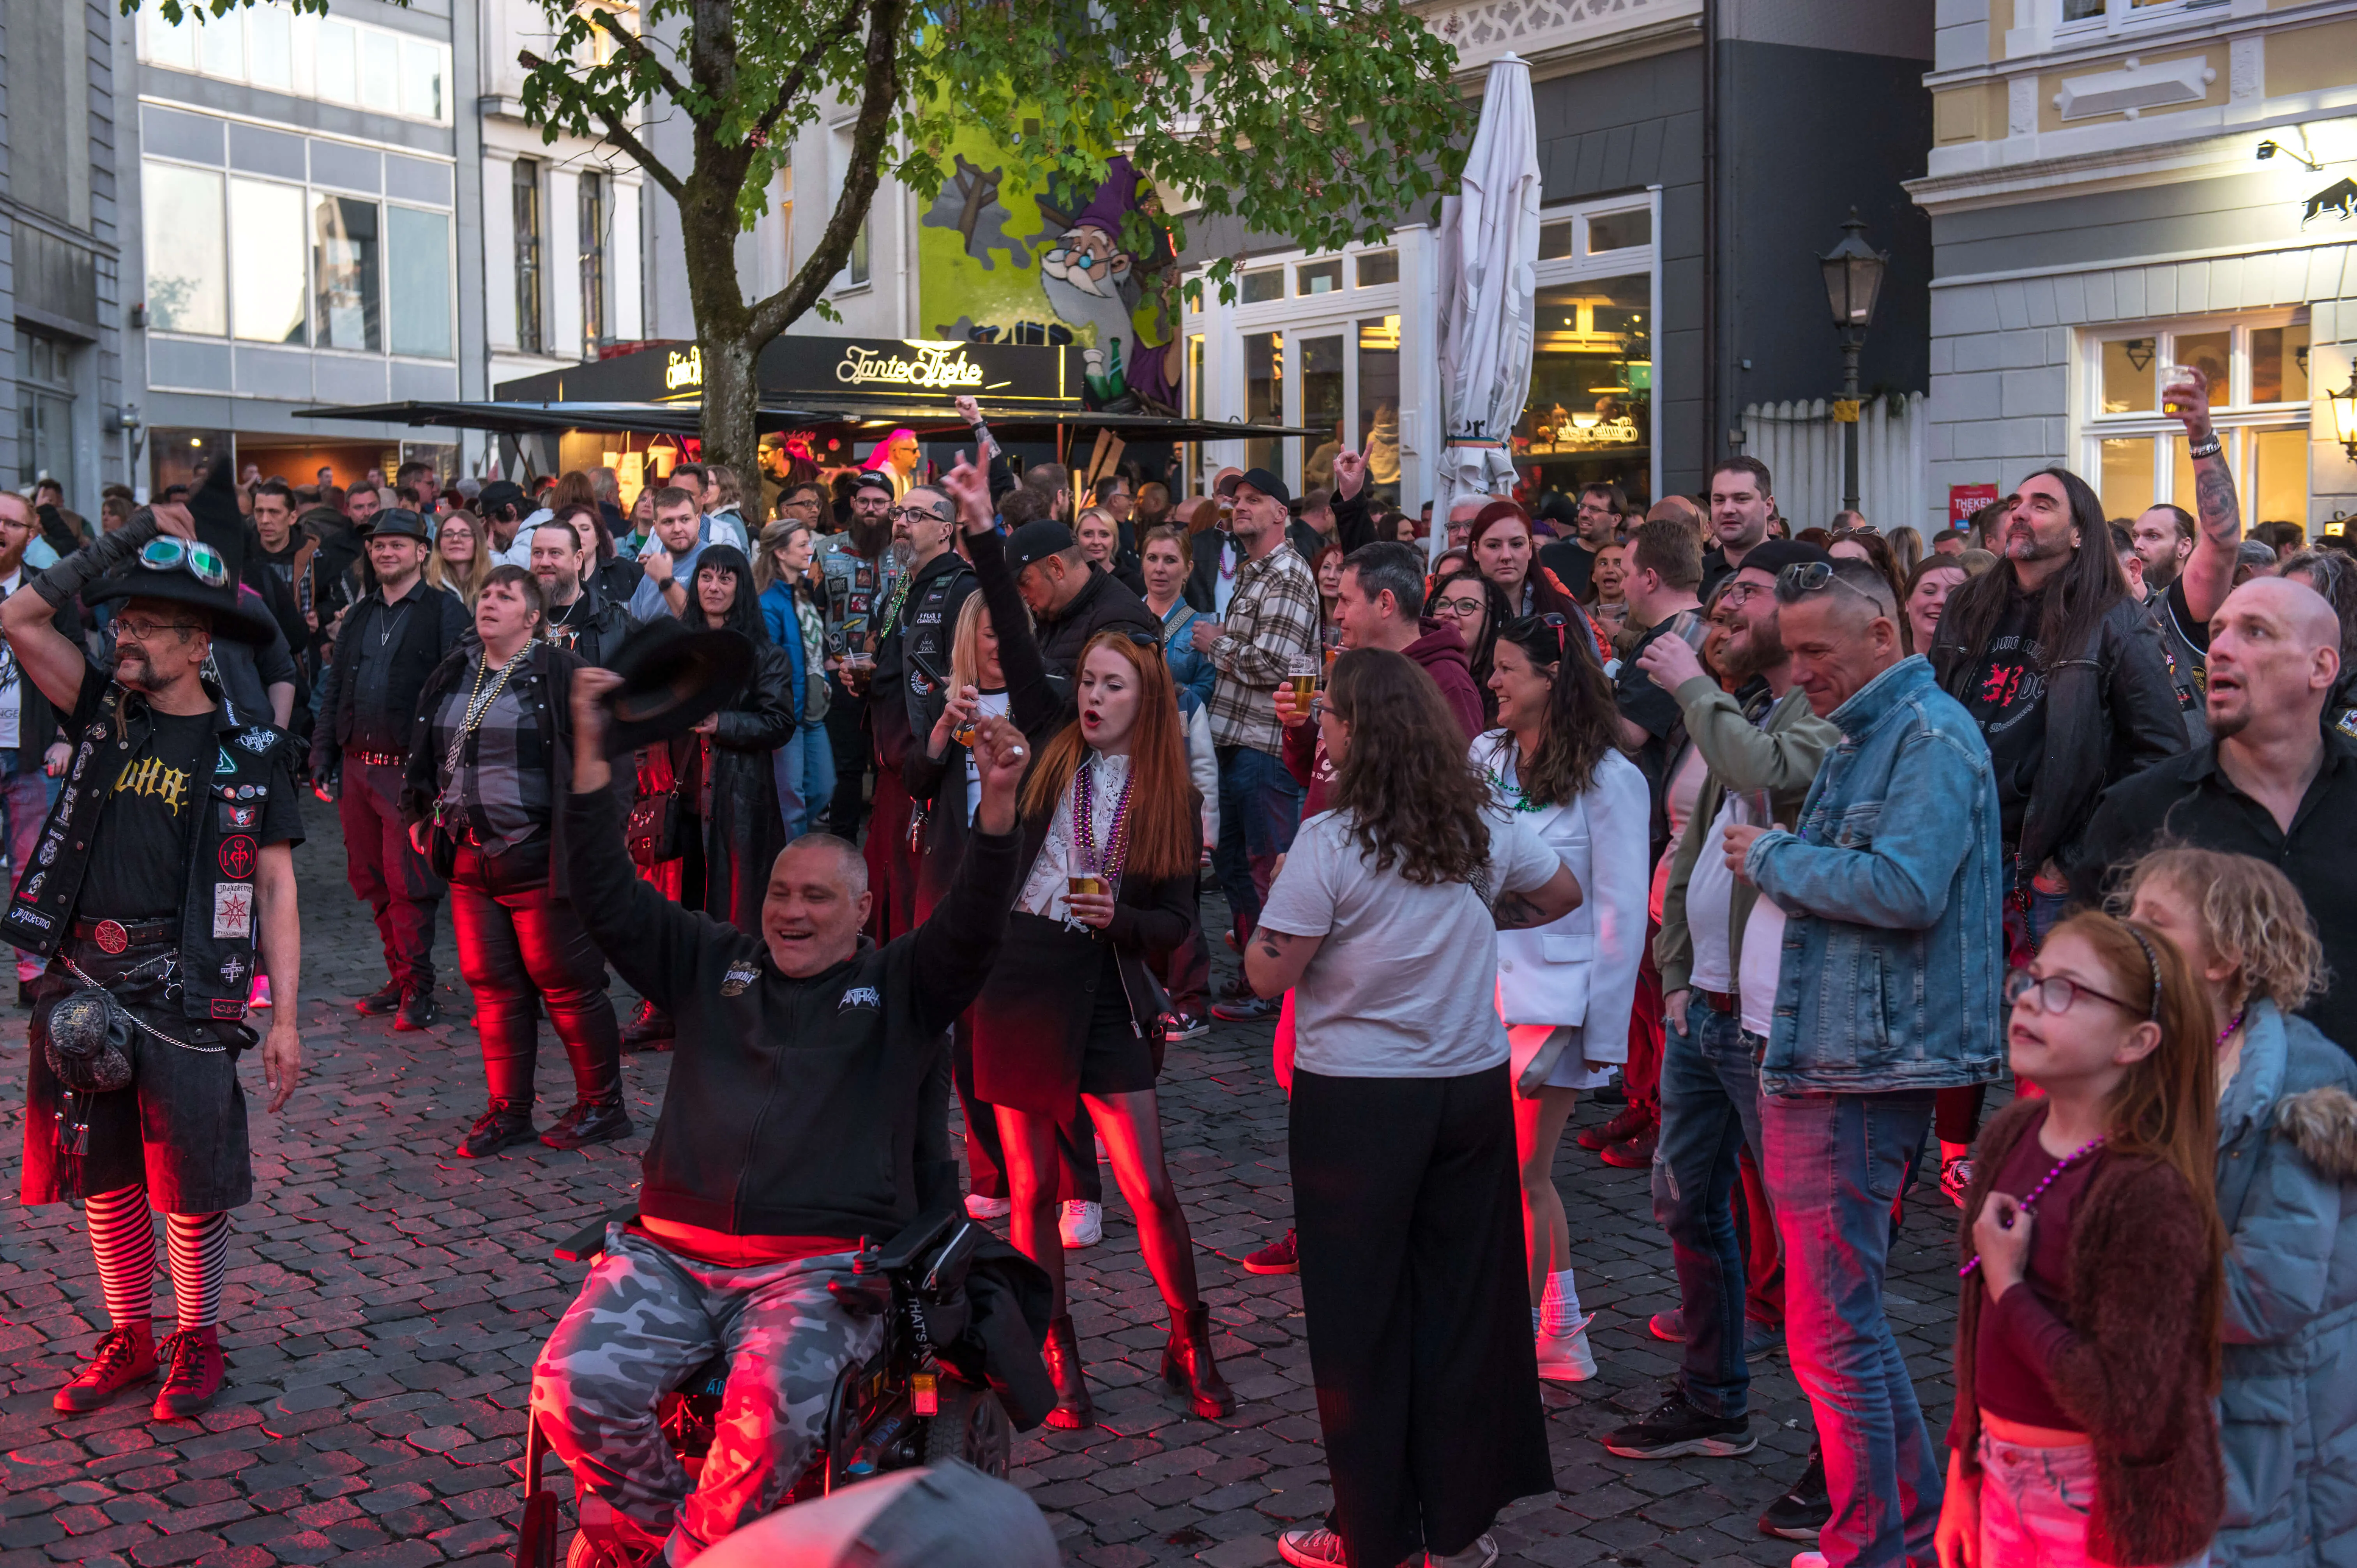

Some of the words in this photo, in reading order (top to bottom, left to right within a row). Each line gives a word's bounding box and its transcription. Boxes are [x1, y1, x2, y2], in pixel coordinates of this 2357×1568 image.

[836, 346, 908, 384] Tante
[908, 347, 983, 388] Theke
[1954, 497, 1994, 510] THEKEN
[837, 986, 881, 1009] ANTHRAX
[908, 1297, 927, 1342] THAT'S
